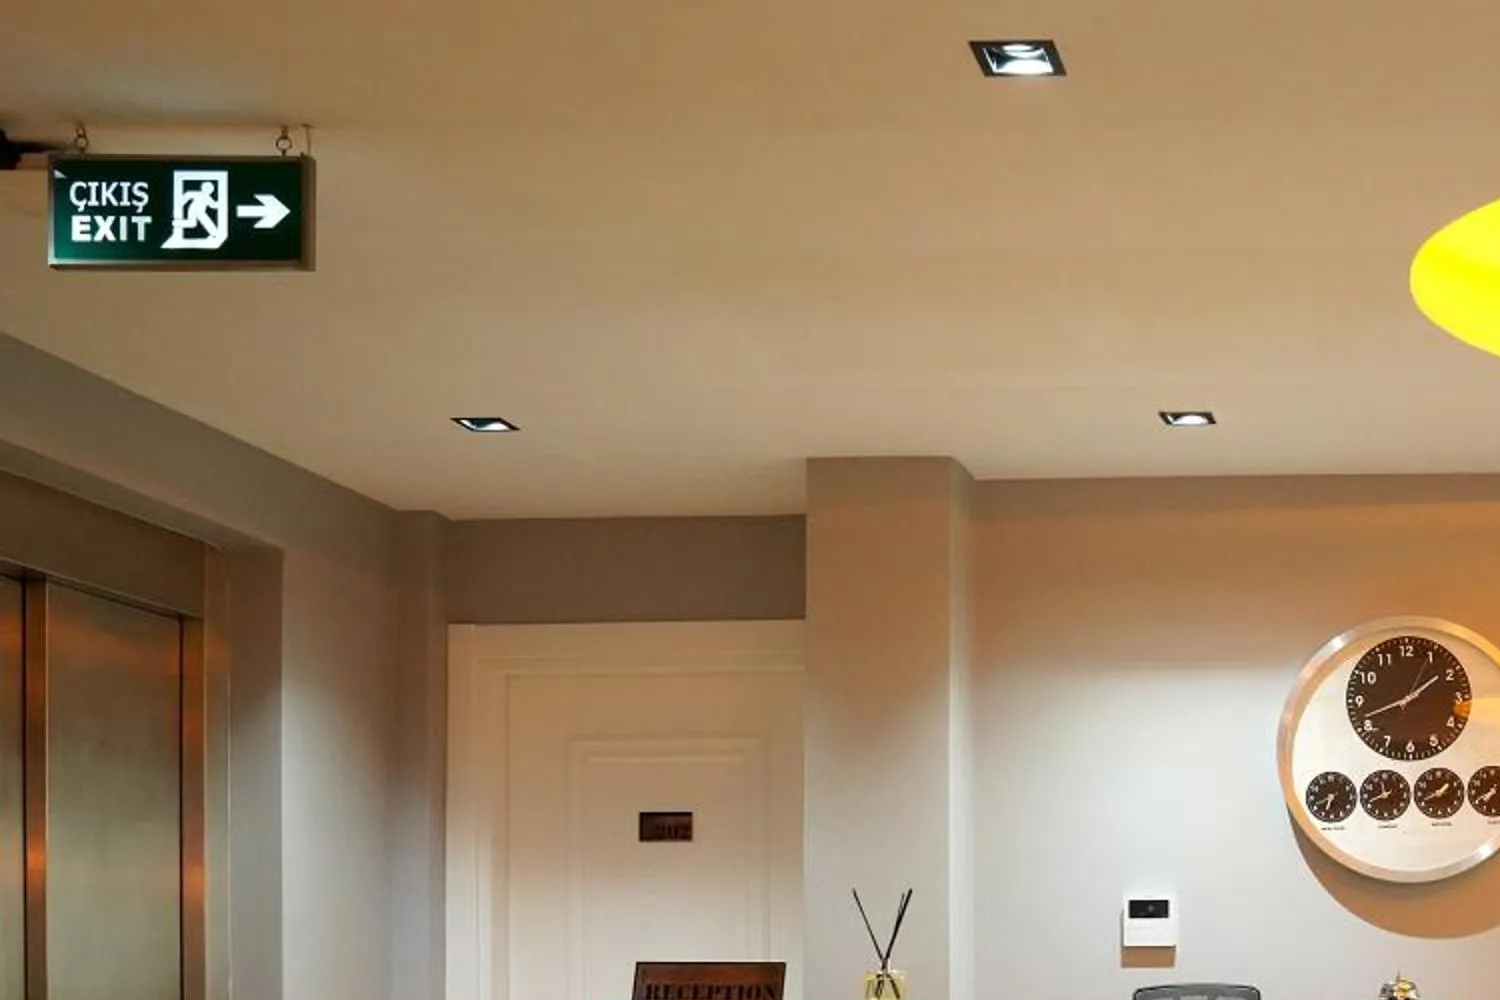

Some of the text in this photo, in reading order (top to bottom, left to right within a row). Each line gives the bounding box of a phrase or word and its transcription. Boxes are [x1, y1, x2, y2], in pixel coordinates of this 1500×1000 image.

[69, 181, 149, 213] ÇIKIŞ
[71, 215, 152, 242] EXIT
[1399, 645, 1414, 657] 12
[1427, 651, 1434, 663] 1
[1377, 653, 1392, 666] 11
[1360, 671, 1377, 685] 10
[1445, 669, 1455, 681] 2
[1355, 695, 1364, 708] 9
[1455, 691, 1463, 705] 3
[1363, 719, 1373, 732] 8
[1446, 716, 1455, 728] 4
[1383, 735, 1391, 747] 7
[1405, 741, 1415, 753] 6
[1429, 735, 1439, 747] 5
[645, 983, 777, 1000] RECEPTION
